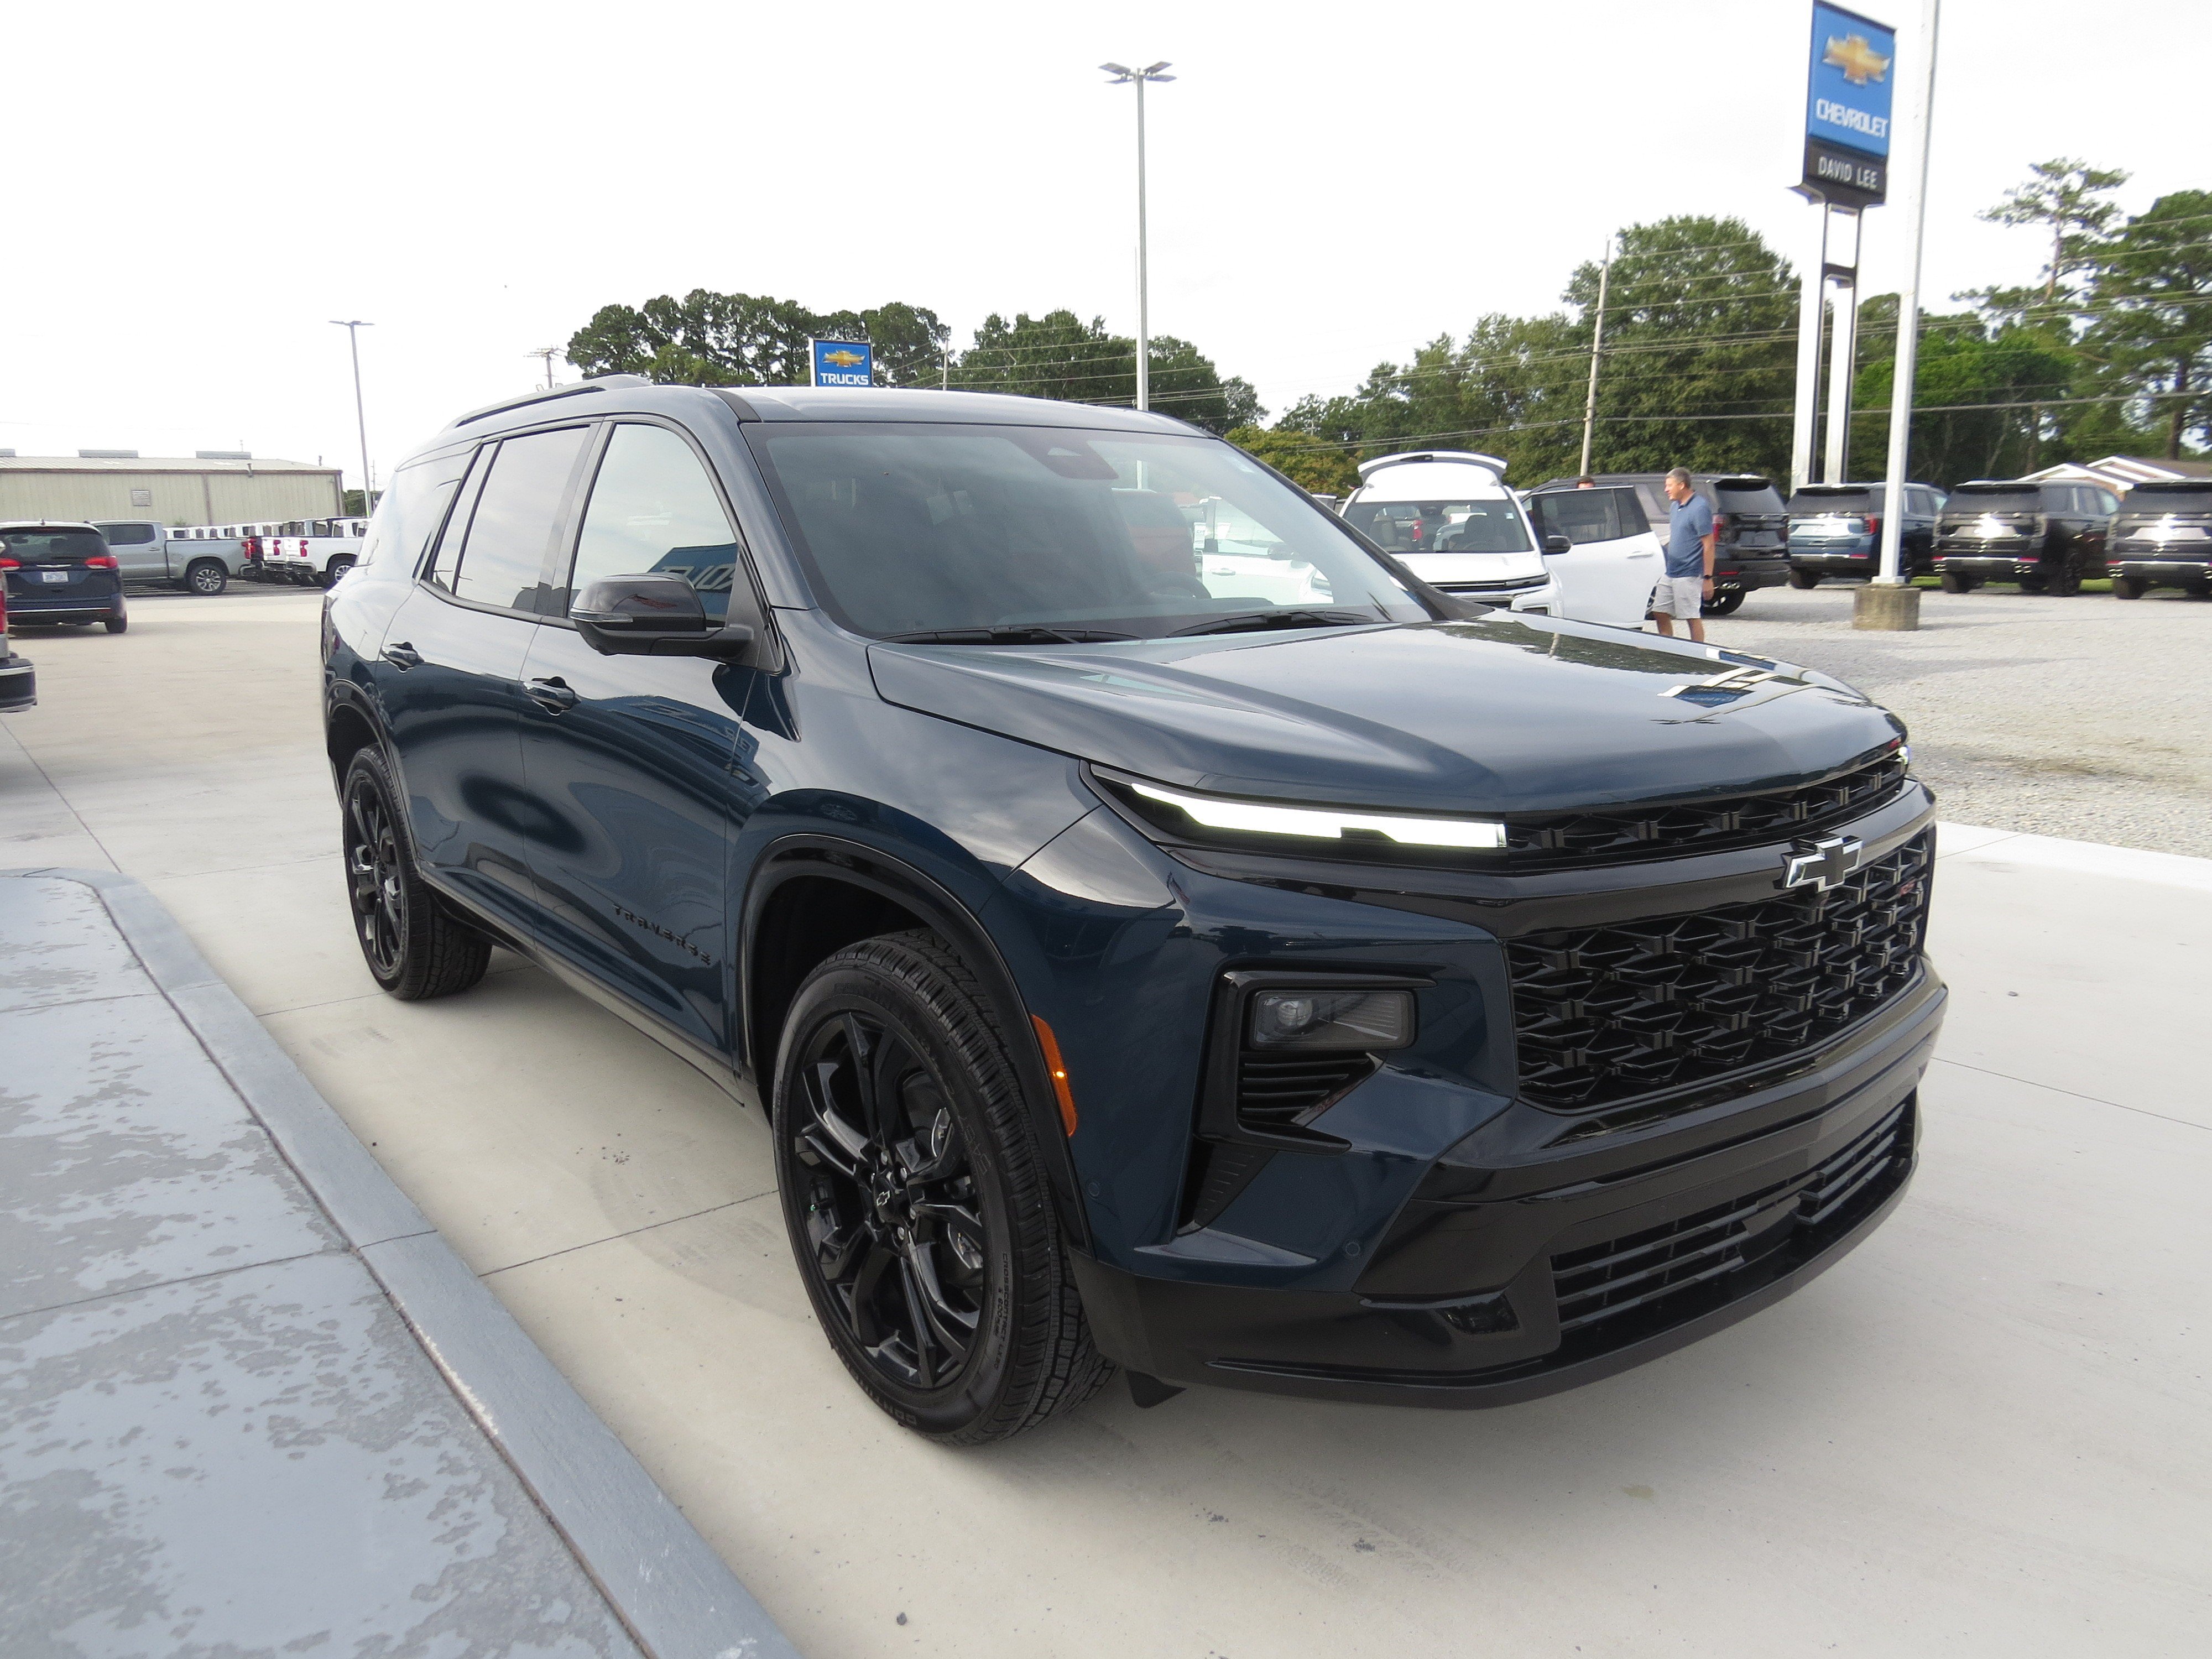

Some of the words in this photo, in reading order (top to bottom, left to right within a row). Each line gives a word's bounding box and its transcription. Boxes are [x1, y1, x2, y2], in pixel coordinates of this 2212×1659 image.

[1816, 98, 1889, 138] CHEVROLET
[1818, 156, 1852, 183] DAVID
[1856, 167, 1877, 190] LEE
[820, 373, 869, 385] TRUCKS
